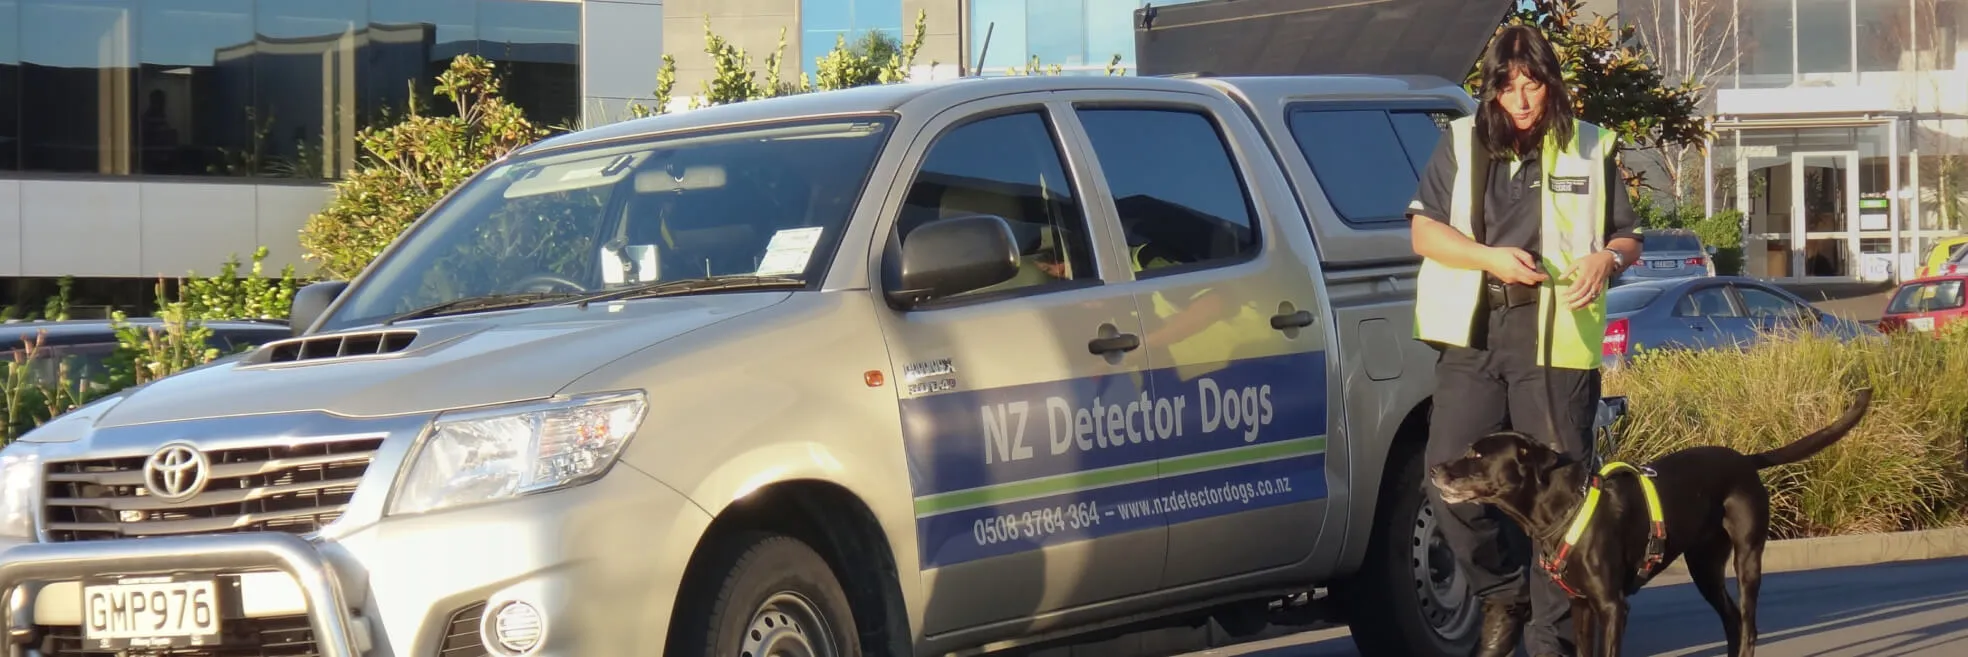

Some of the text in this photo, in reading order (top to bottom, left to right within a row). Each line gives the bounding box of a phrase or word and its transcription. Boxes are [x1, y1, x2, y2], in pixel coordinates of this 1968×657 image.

[981, 377, 1273, 465] NZ Detector Dogs
[973, 514, 1019, 546] 0508
[1021, 506, 1065, 537] 3784
[1067, 500, 1100, 529] 364
[1117, 477, 1292, 520] www.nzdetectordogs.co.nz
[91, 589, 211, 632] GMP976
